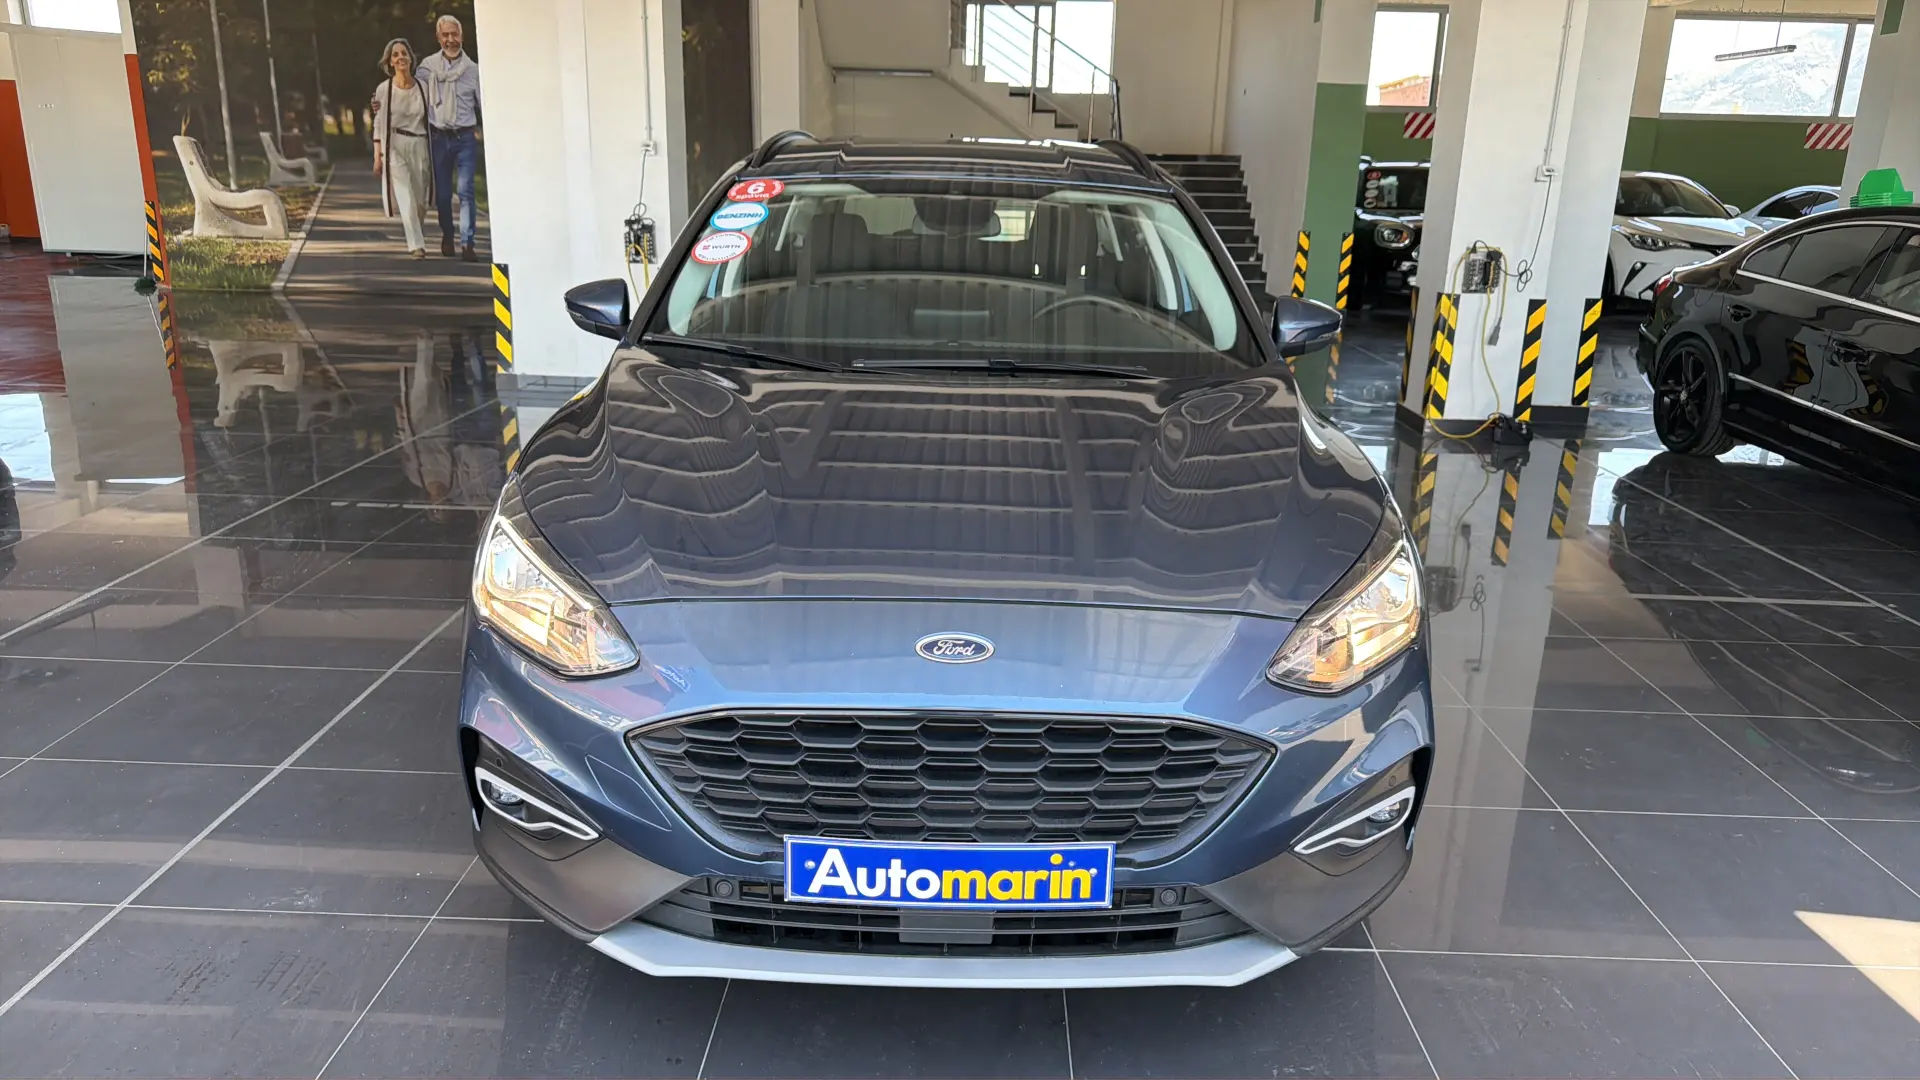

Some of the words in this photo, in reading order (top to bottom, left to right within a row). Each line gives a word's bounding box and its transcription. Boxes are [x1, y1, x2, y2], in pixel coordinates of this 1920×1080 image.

[747, 181, 766, 194] 6
[933, 640, 976, 656] Ford
[808, 848, 1092, 901] Automarin
